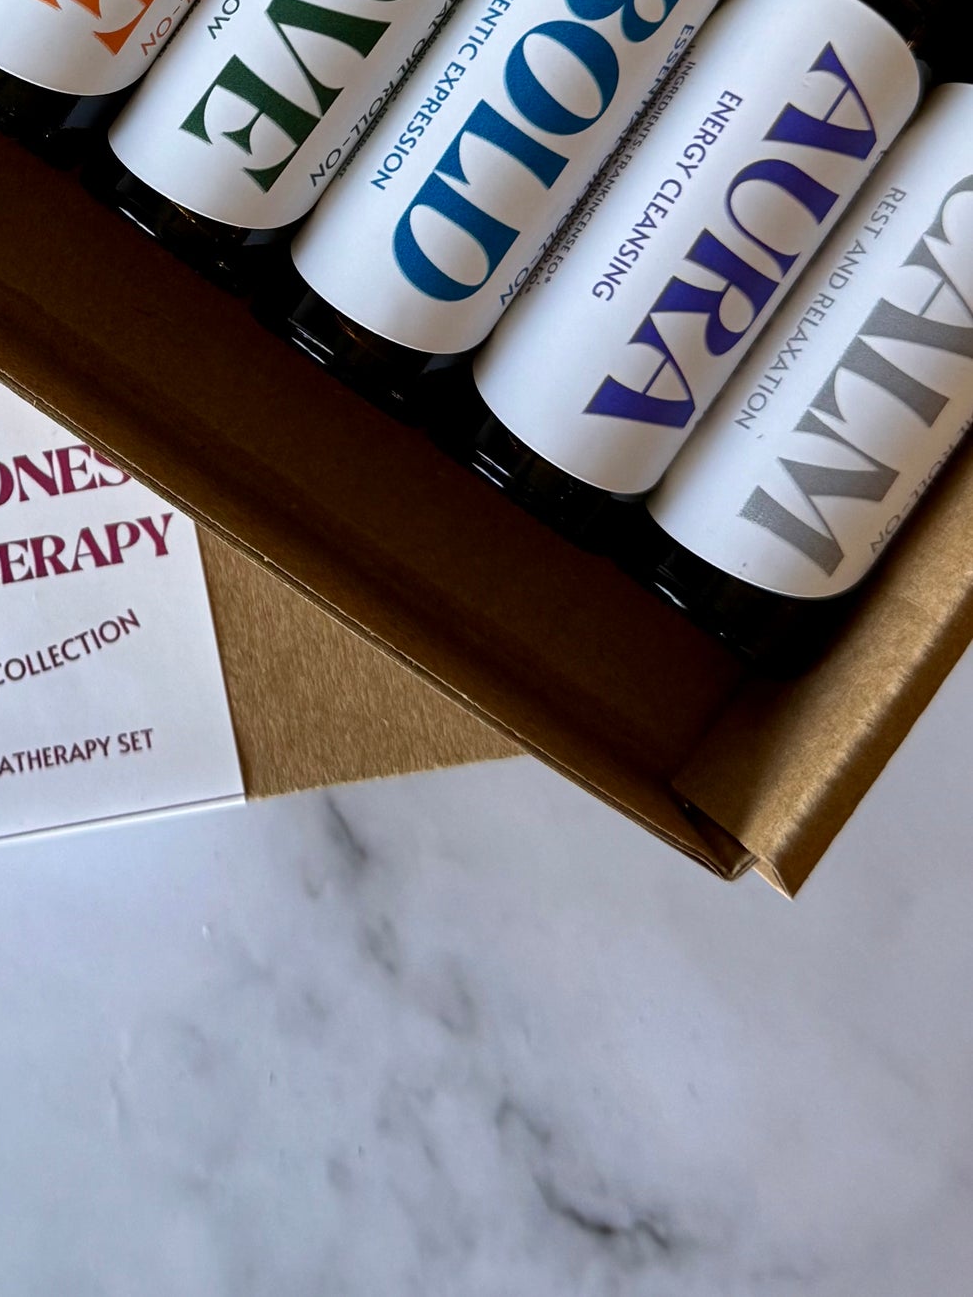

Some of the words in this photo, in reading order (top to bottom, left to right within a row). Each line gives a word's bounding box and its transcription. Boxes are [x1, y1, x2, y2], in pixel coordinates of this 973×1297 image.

[395, 36, 429, 79] OIL
[309, 78, 397, 187] ROLL-ON
[370, 62, 466, 191] EXPRESSION
[628, 60, 696, 152] INGREDIENTS:
[676, 89, 743, 180] ENERGY
[559, 153, 633, 254] FRANKINCENSE
[582, 40, 877, 429] AURA
[592, 178, 684, 301] CLEANSING
[872, 187, 907, 239] REST
[827, 239, 868, 290] AND
[734, 291, 836, 430] RELAXATION
[117, 728, 155, 754] SET
